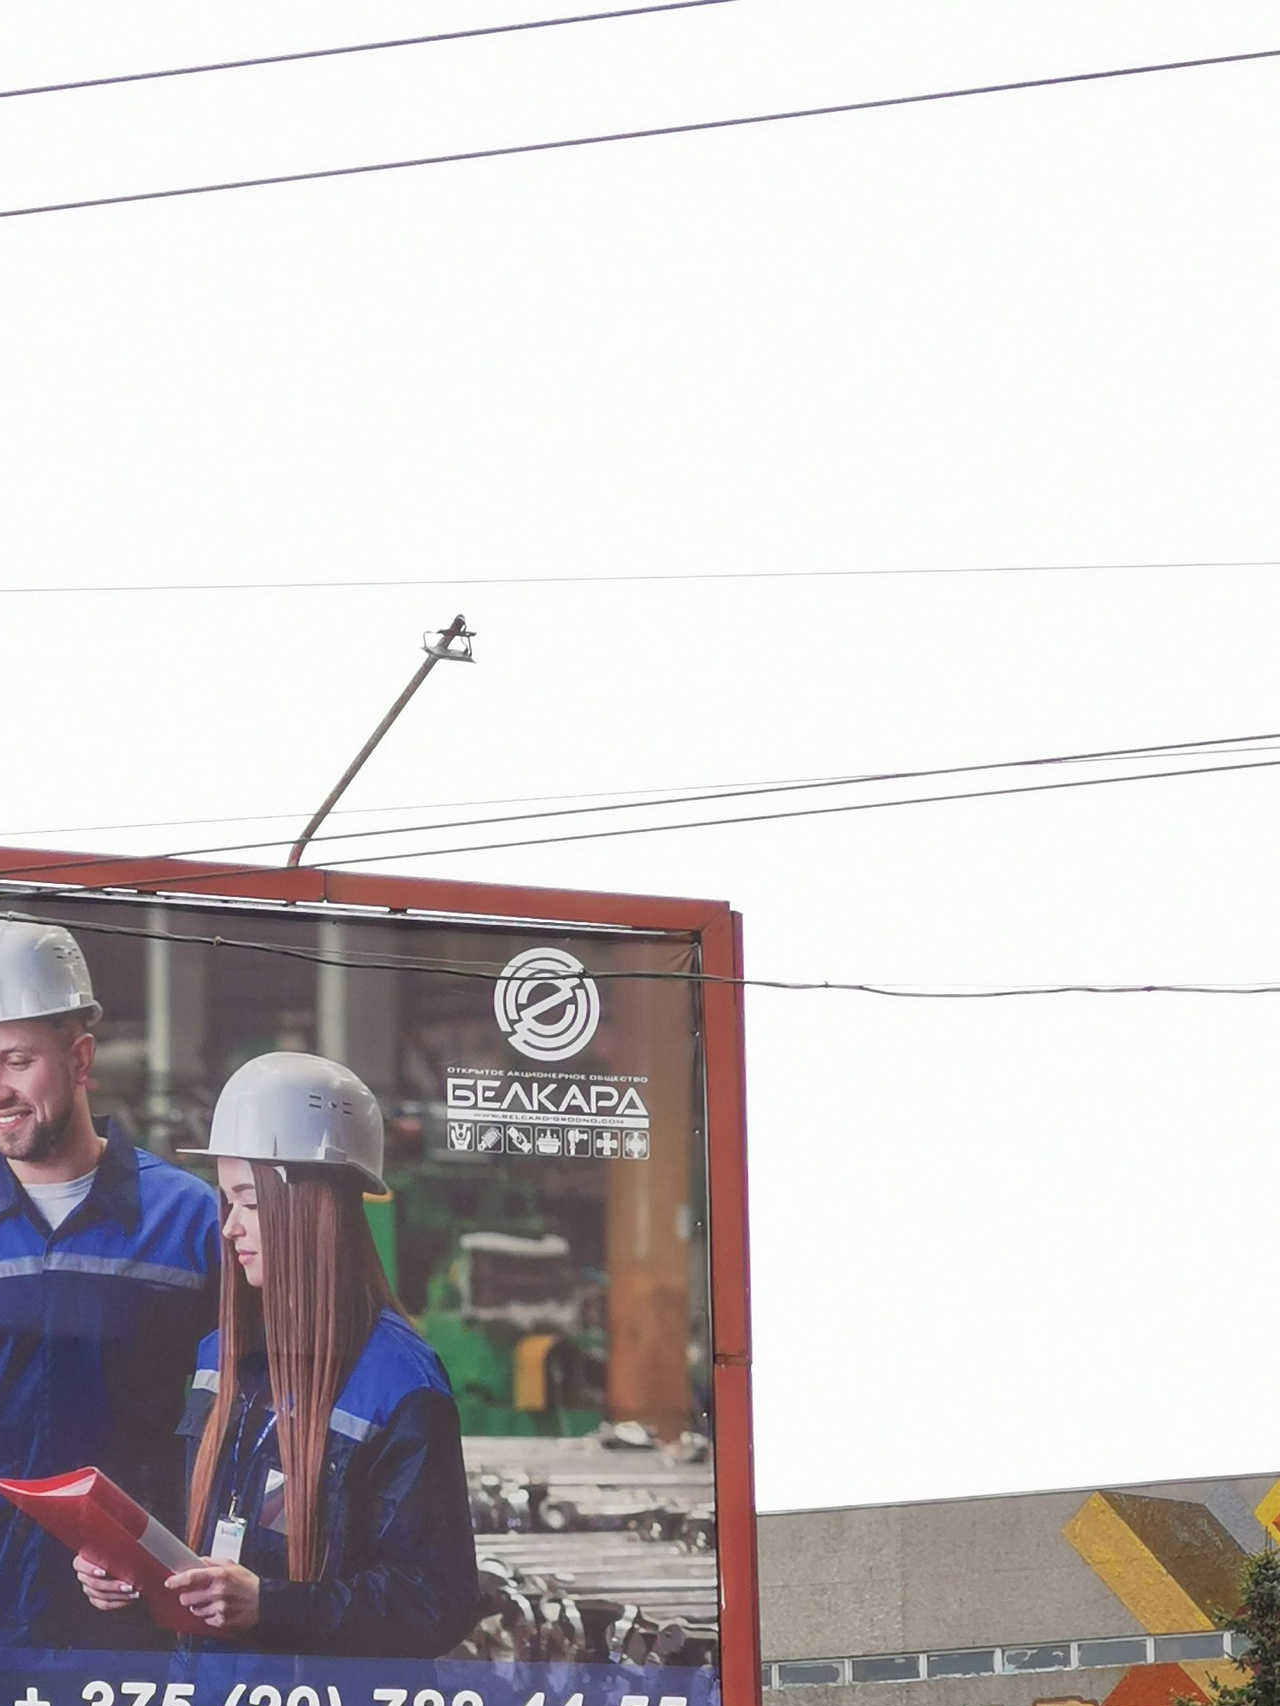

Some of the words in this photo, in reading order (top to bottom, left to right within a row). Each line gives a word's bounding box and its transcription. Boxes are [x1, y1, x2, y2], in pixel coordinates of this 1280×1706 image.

[447, 1066, 505, 1077] ОТКРЫТОЕ
[507, 1070, 587, 1080] АКЦИОНЕРНОЕ
[589, 1074, 649, 1083] ОБЩЕСТВО
